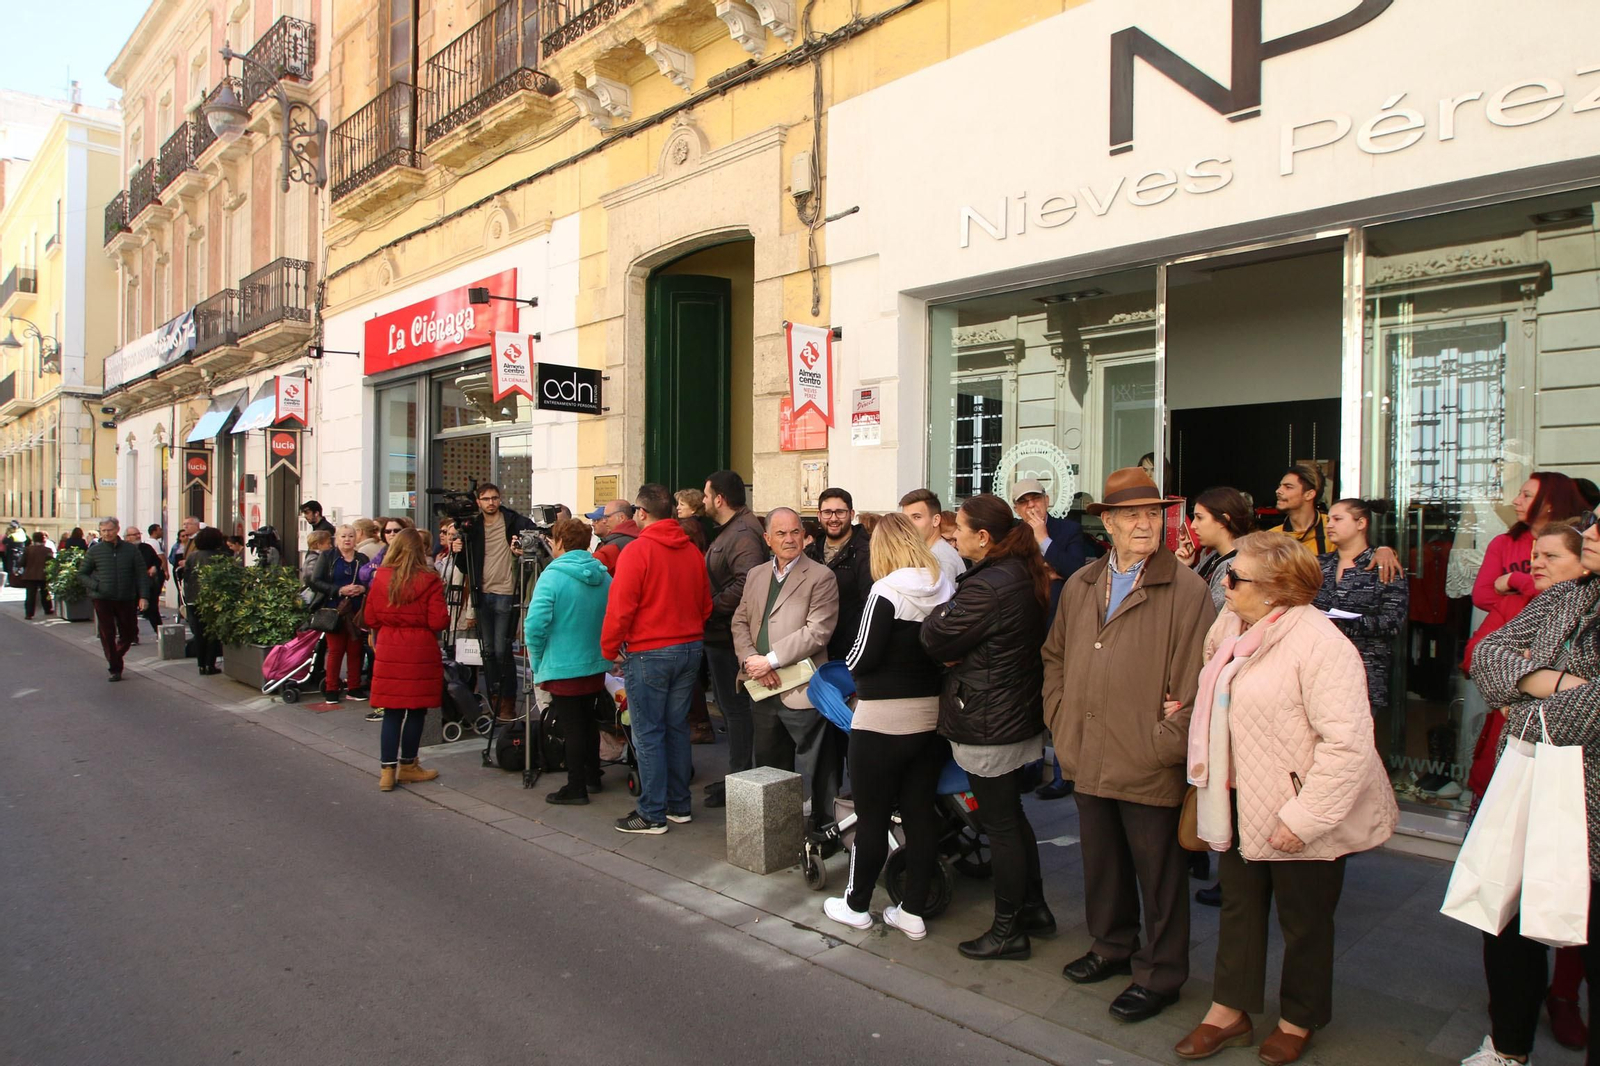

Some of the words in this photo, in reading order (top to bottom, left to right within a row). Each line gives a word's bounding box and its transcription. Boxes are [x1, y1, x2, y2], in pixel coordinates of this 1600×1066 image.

[959, 155, 1234, 248] Nieves
[387, 324, 406, 355] La
[410, 307, 476, 347] Ciénaga
[798, 376, 822, 386] centro
